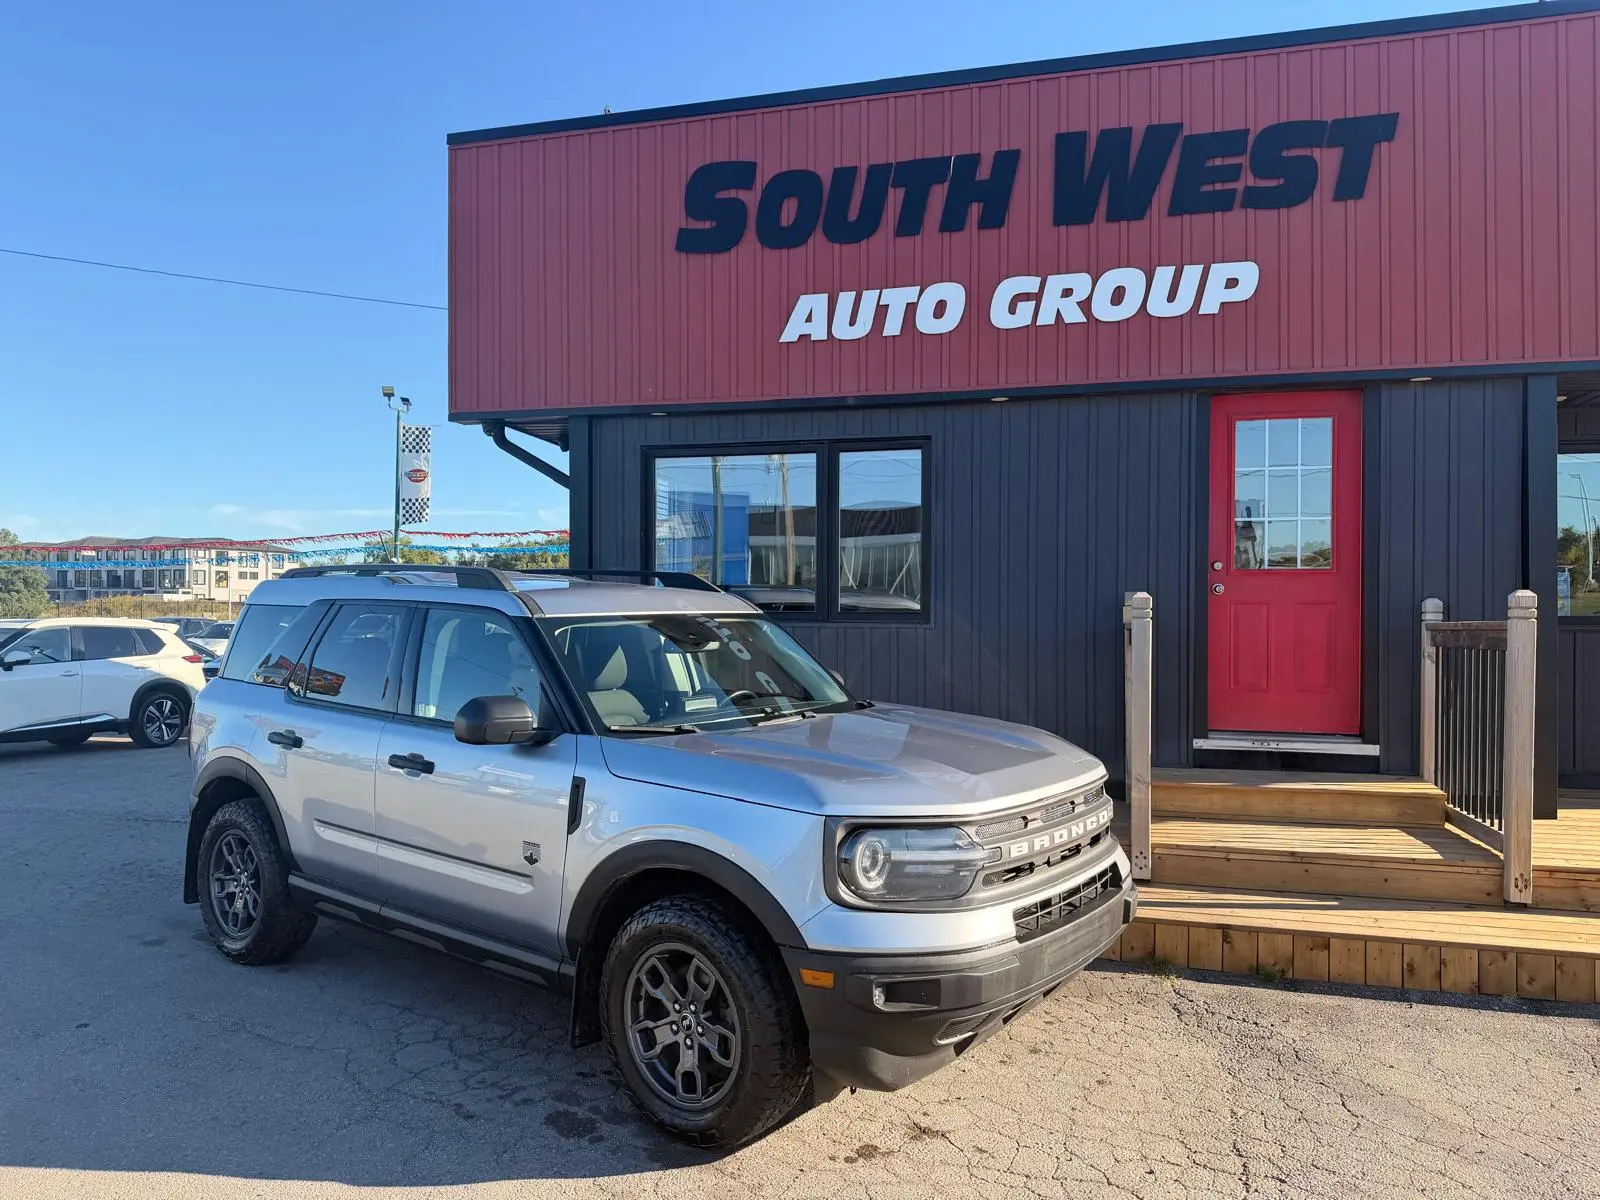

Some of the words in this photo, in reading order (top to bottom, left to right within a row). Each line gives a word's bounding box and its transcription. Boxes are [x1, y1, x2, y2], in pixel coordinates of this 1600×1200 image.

[675, 148, 1022, 254] SOUTH
[1053, 112, 1400, 226] WEST
[778, 281, 966, 343] AUTO
[989, 260, 1260, 330] GROUP
[1009, 809, 1108, 859] BRONCO
